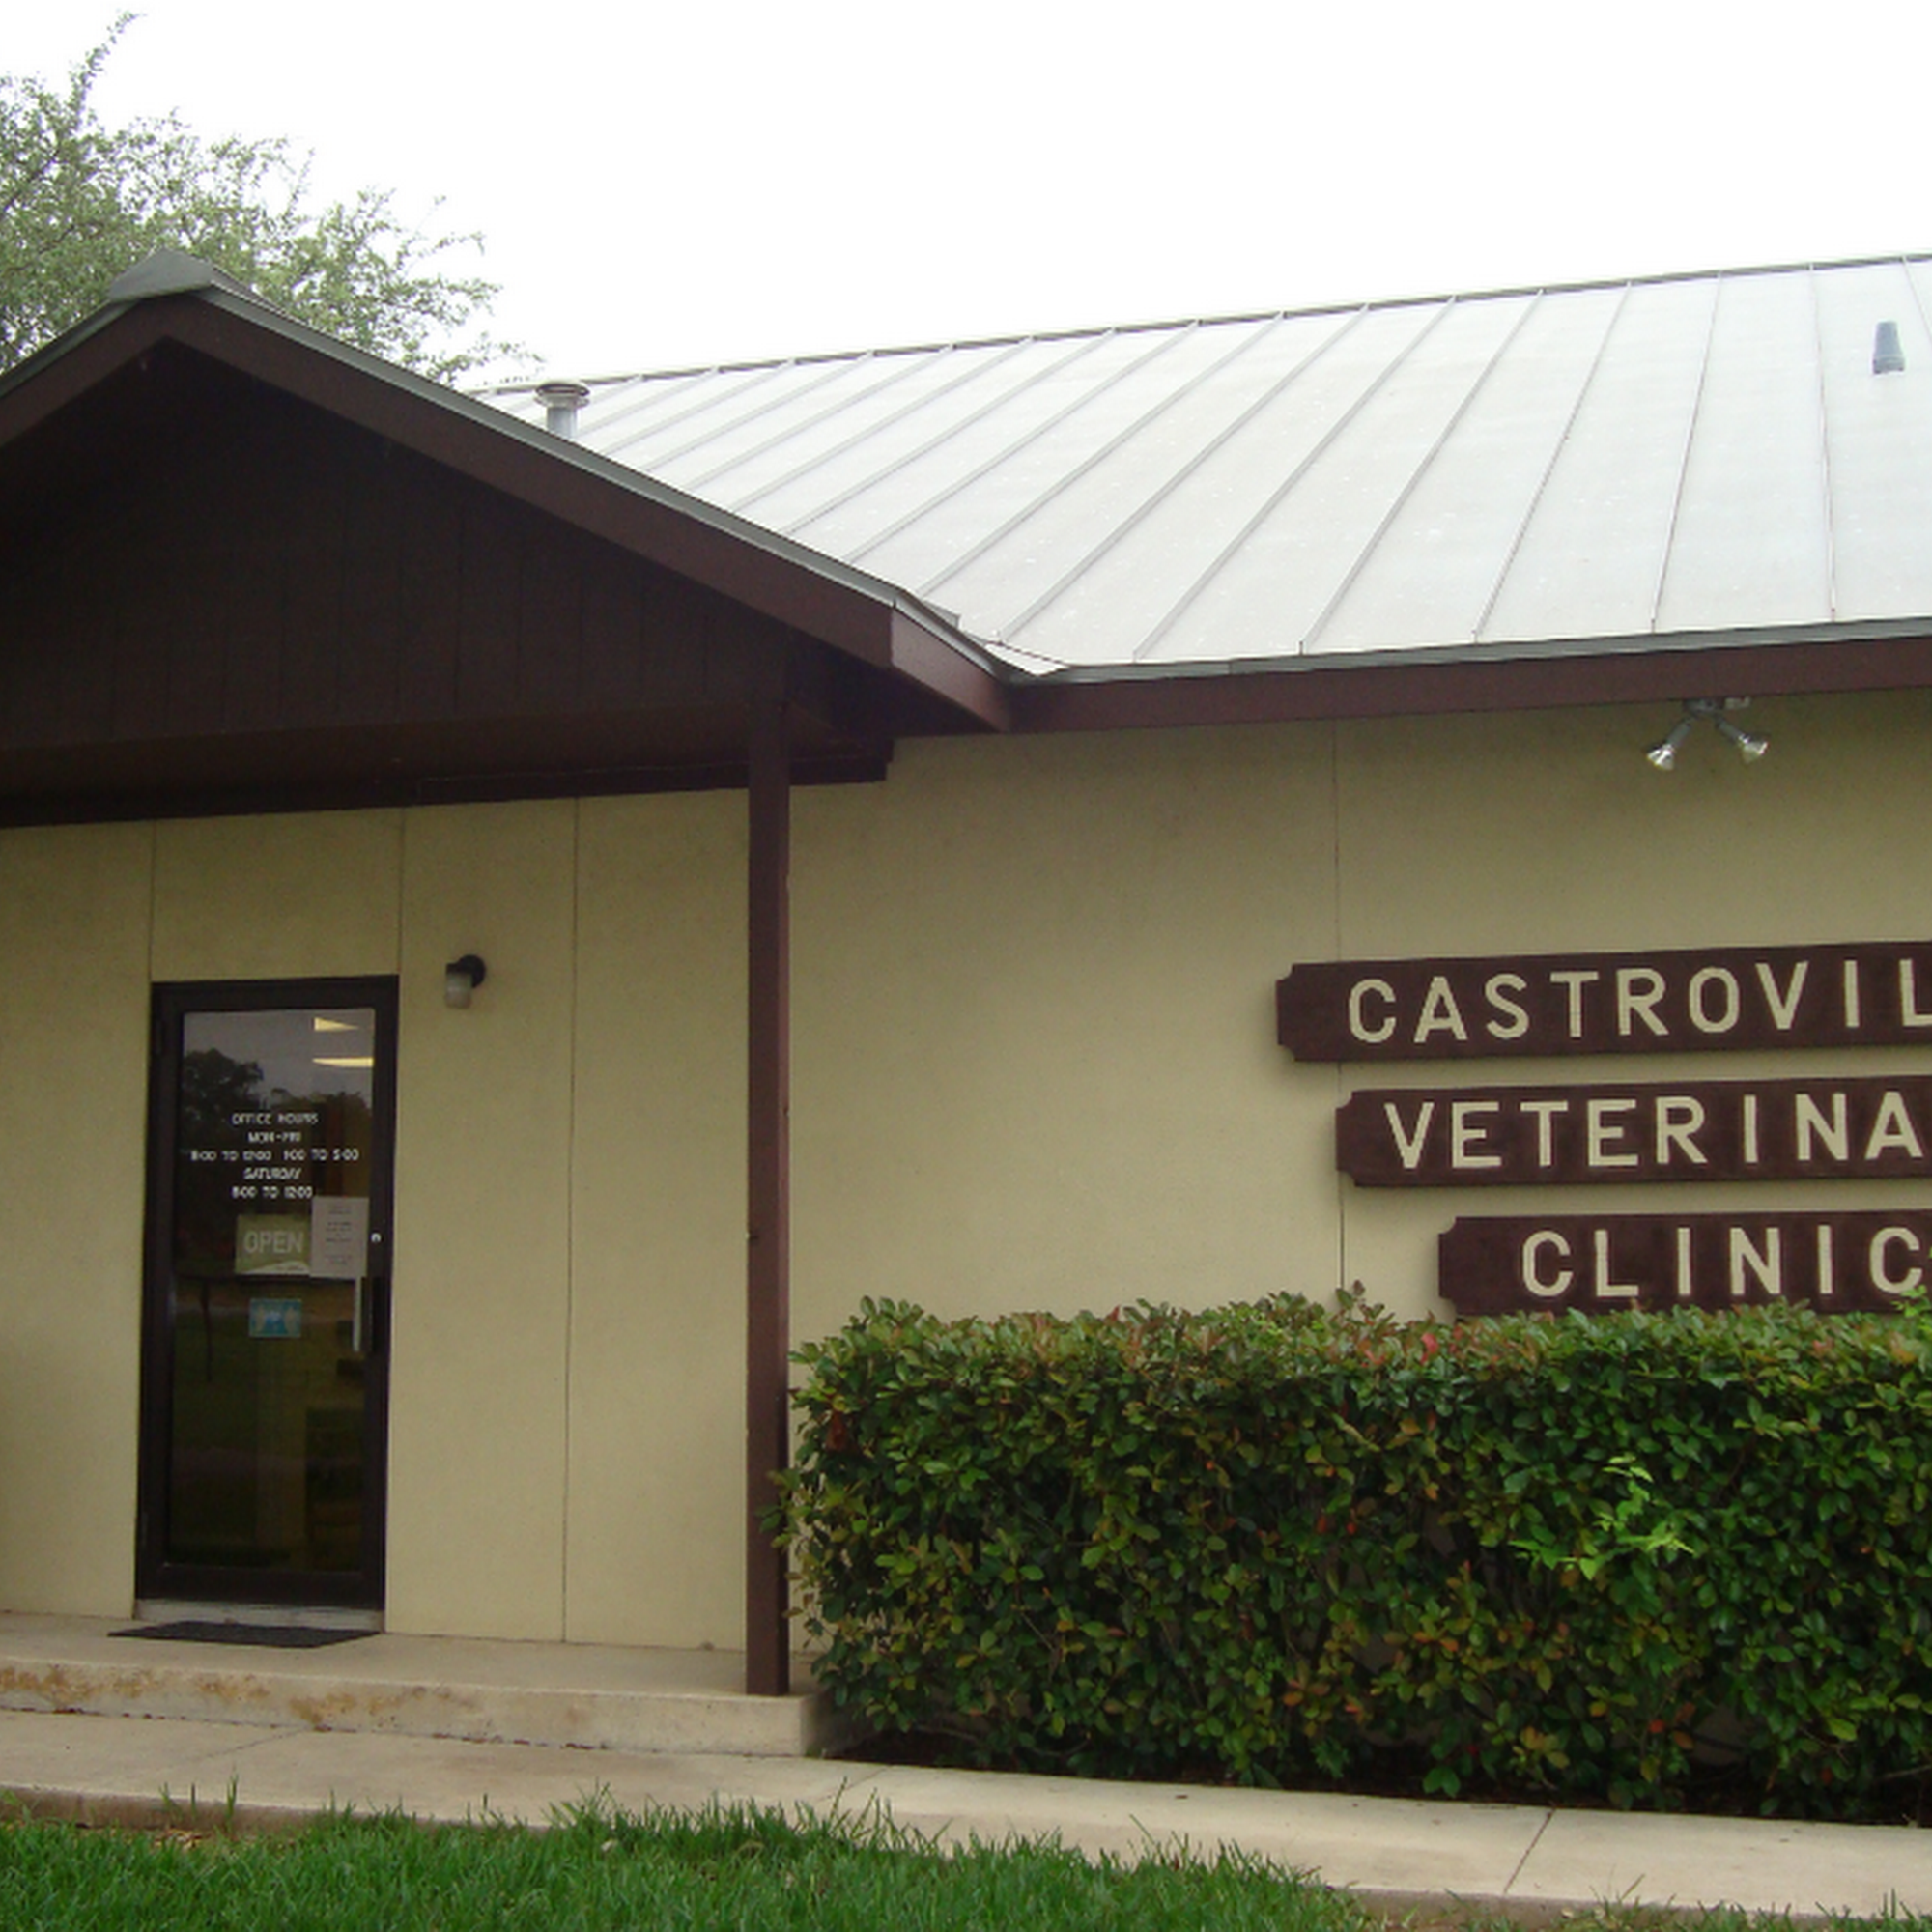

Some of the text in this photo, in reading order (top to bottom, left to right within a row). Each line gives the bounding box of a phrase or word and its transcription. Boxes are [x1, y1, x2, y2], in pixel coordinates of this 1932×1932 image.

[1349, 958, 1932, 1043] CASTROVIL
[232, 1113, 319, 1125] OFFICE HOURS
[1384, 1091, 1923, 1168] VETERINA
[221, 1150, 239, 1161] TO
[311, 1148, 327, 1161] TO
[243, 1167, 302, 1179] SATURDAY
[262, 1186, 279, 1199] TO
[243, 1230, 305, 1254] OPEN
[1521, 1225, 1922, 1297] CLINIC
